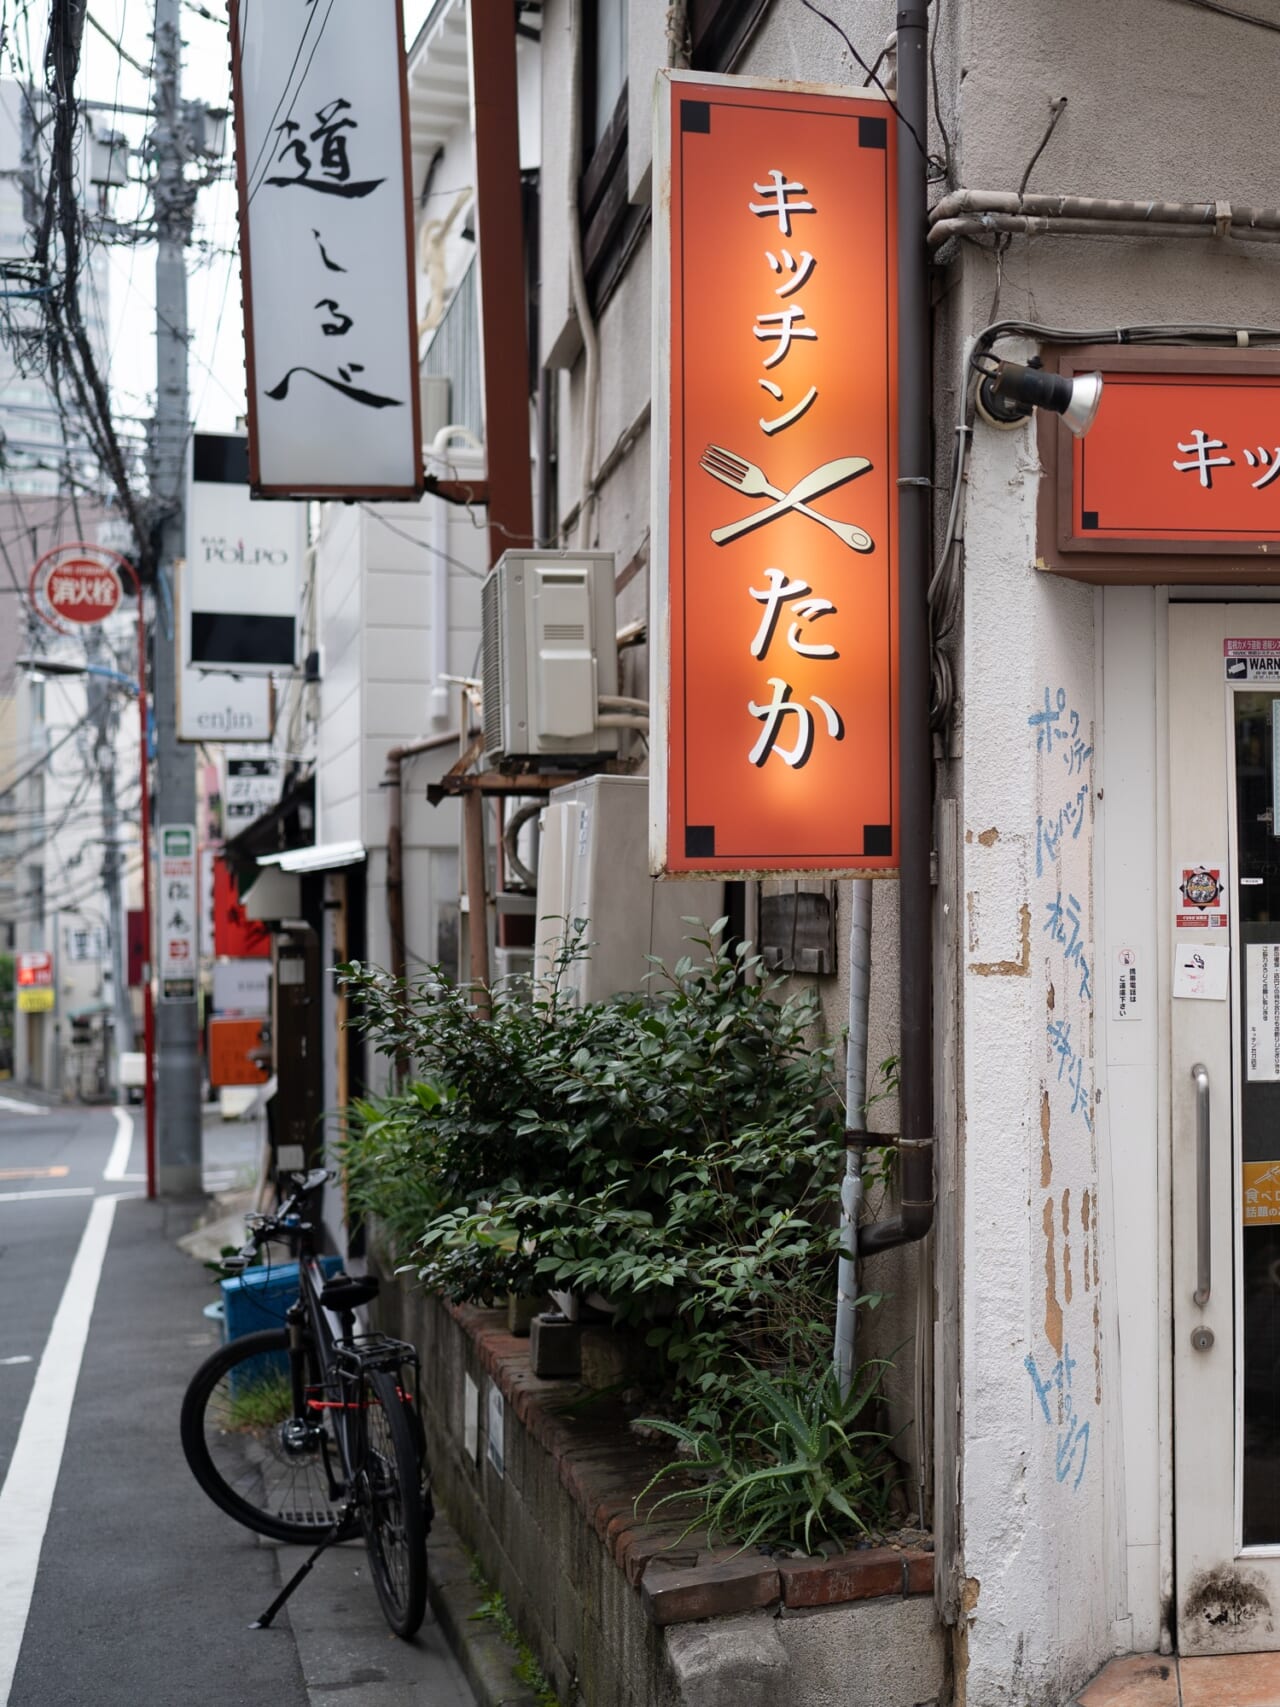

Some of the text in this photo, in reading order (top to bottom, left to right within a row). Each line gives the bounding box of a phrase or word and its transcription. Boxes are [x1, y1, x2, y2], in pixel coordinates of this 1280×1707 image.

[264, 98, 404, 408] 道しるべ
[205, 545, 288, 565] POLPO
[747, 169, 845, 768] キッチン たか
